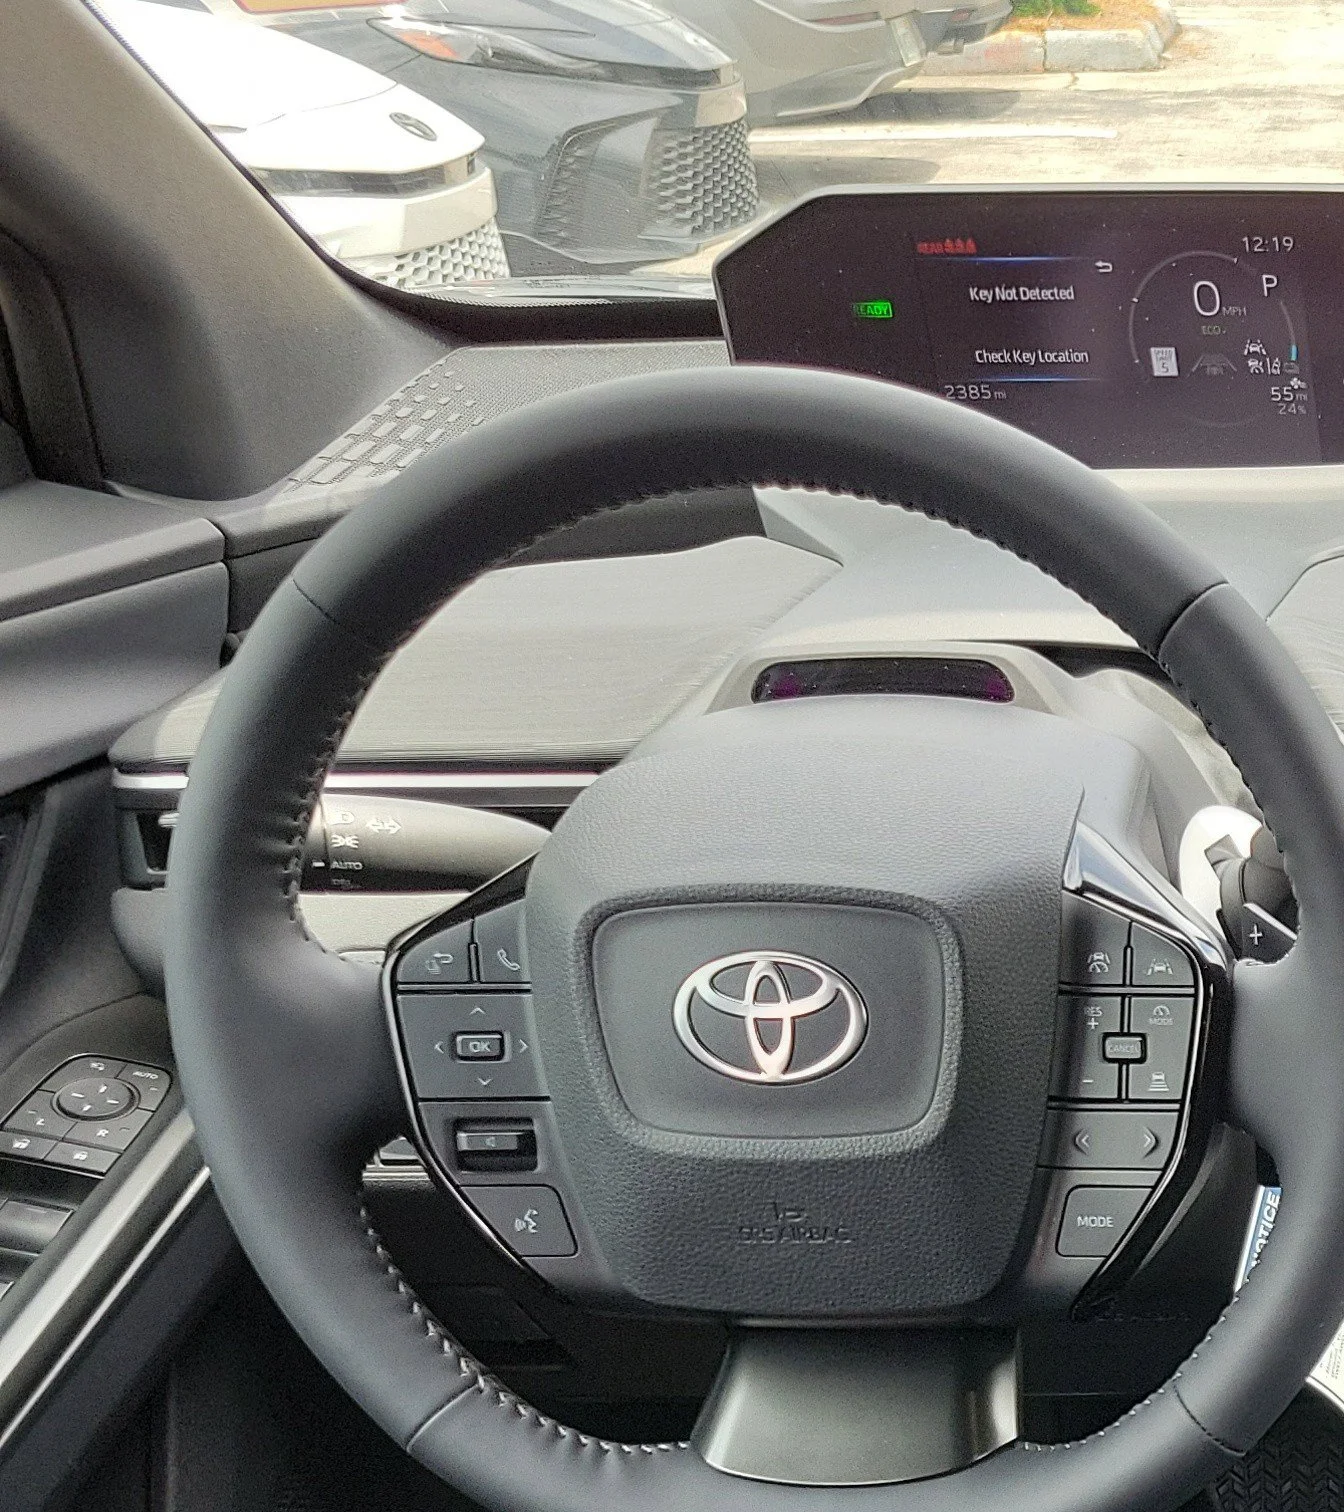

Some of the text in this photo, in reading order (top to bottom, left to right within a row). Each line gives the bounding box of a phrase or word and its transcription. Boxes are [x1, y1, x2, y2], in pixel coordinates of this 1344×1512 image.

[1242, 236, 1294, 252] 12:19
[1262, 274, 1278, 297] P
[969, 285, 1075, 303] Key Not Detected
[1193, 280, 1221, 316] 0
[1222, 305, 1247, 317] MPH
[975, 349, 1089, 366] Check Key Location
[1160, 362, 1170, 374] 5
[944, 384, 1007, 400] 2385 mi
[1271, 387, 1294, 401] 55
[470, 1041, 491, 1052] OK
[1077, 1215, 1114, 1228] MODE
